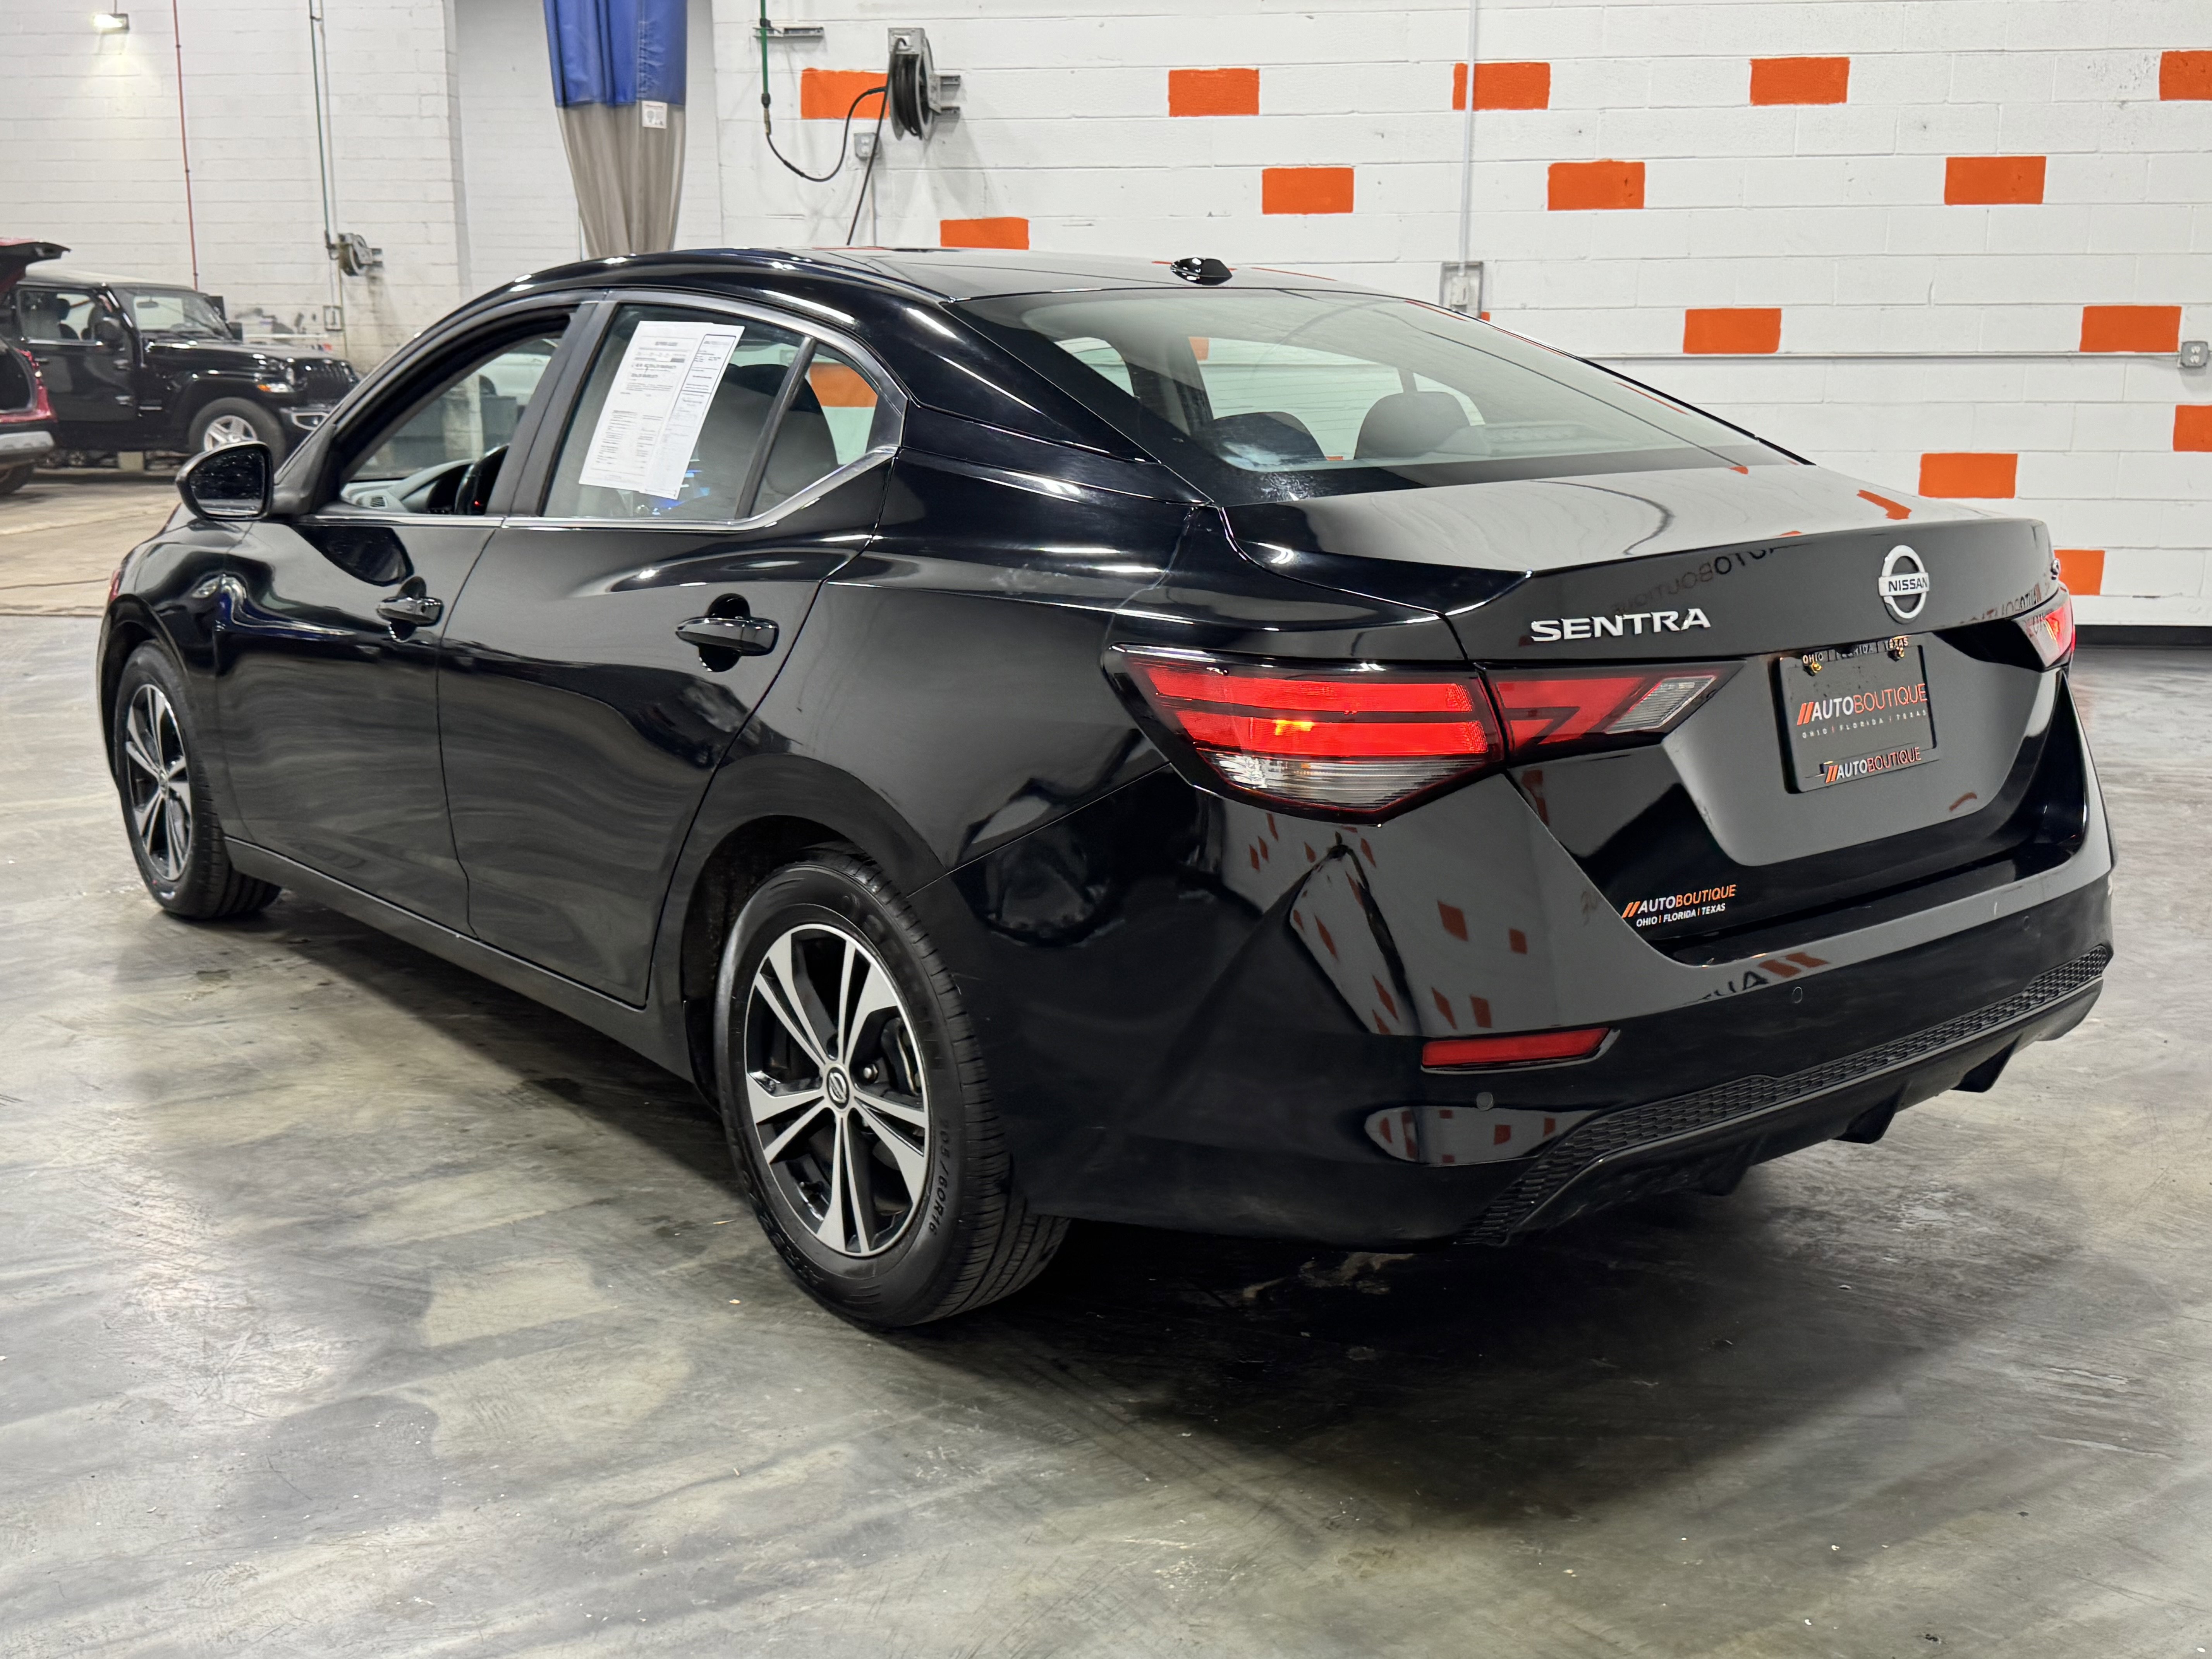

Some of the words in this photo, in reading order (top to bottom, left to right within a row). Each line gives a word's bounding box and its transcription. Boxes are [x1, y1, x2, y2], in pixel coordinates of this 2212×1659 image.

[1888, 577, 1929, 592] NISSAN
[1531, 608, 1711, 642] SENTRA
[1802, 653, 1823, 664] OHIO
[1811, 683, 1927, 722] AUTOBOUTIQUE
[1802, 728, 1827, 738] OHIO
[1839, 718, 1884, 732] FLORIDA
[1836, 747, 1922, 780] AUTOBOUTIQUE
[1638, 884, 1737, 914] AUTOBOUTIQUE
[1636, 916, 1657, 927] OHIO
[1663, 909, 1697, 923] FLORIDA
[1702, 903, 1726, 916] TEXAS
